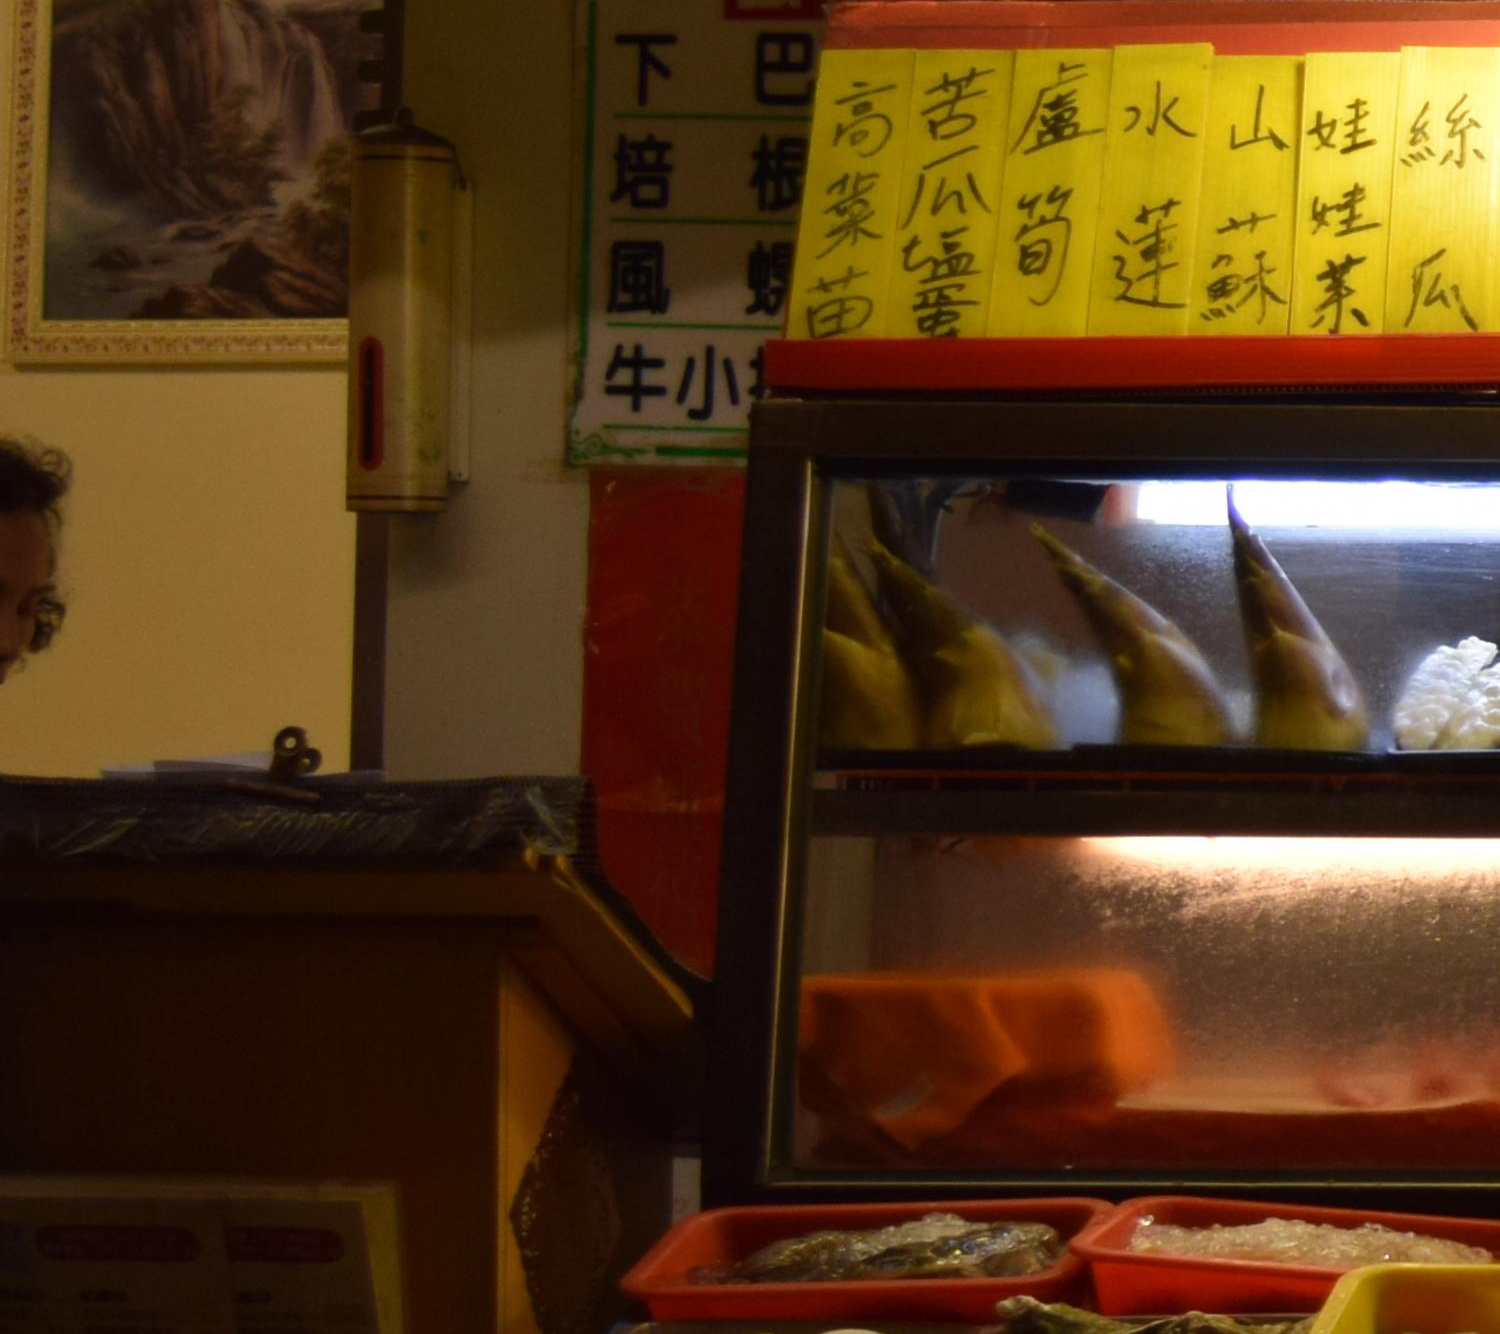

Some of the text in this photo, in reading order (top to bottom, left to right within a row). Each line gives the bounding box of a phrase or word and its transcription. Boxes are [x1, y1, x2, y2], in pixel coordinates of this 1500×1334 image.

[1113, 79, 1198, 311] 水蓮
[1199, 85, 1288, 325] 山蘇
[1307, 100, 1383, 334] 娃娃菜
[1400, 93, 1485, 332] 絲瓜
[604, 344, 766, 421] 牛小
